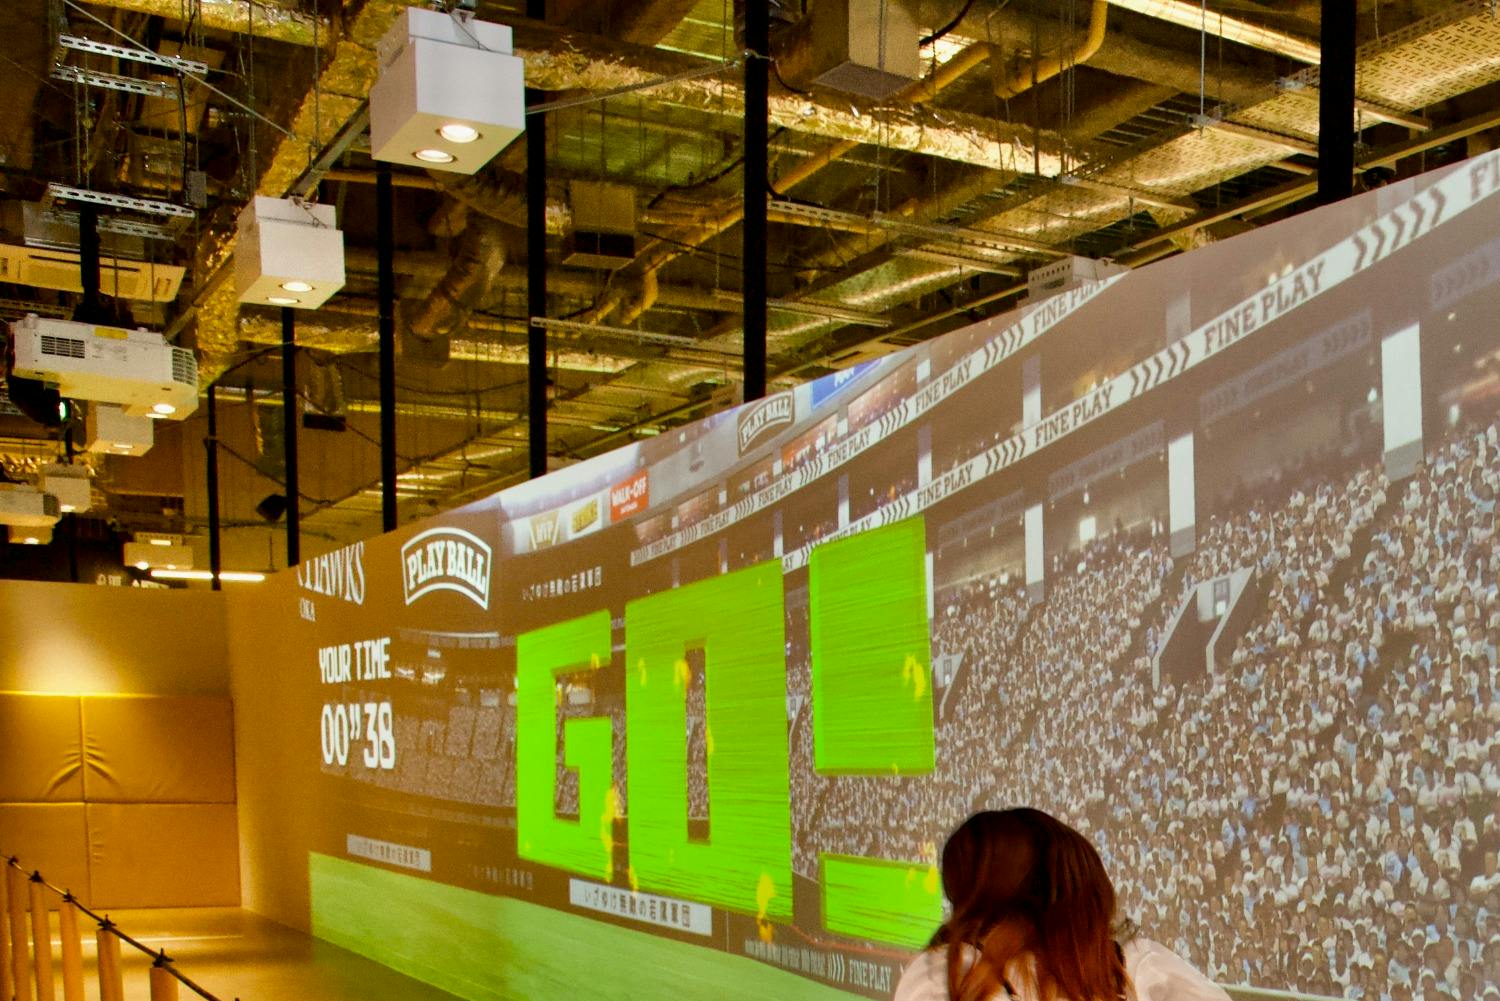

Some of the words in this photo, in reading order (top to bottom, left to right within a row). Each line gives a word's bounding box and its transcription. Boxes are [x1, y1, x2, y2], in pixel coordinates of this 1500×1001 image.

[1033, 292, 1068, 335] FINE
[1204, 301, 1256, 356] FINE
[1262, 260, 1326, 320] PLAY
[915, 381, 941, 414] FINE
[942, 359, 973, 402] PLAY
[742, 409, 766, 443] PLAY
[766, 396, 791, 422] BALL
[1035, 409, 1071, 448] FINE
[1072, 386, 1114, 431] PLAY
[827, 446, 849, 469] FINE
[849, 430, 871, 458] PLAY
[774, 478, 793, 501] PLAY
[917, 484, 942, 509] FINE
[943, 464, 974, 494] PLAY
[407, 540, 446, 591] PLAY
[446, 540, 487, 595] BALL
[318, 643, 352, 684] YOUR
[354, 637, 392, 681] TIME
[849, 959, 868, 988] FINE
[869, 963, 892, 993] PLAY
